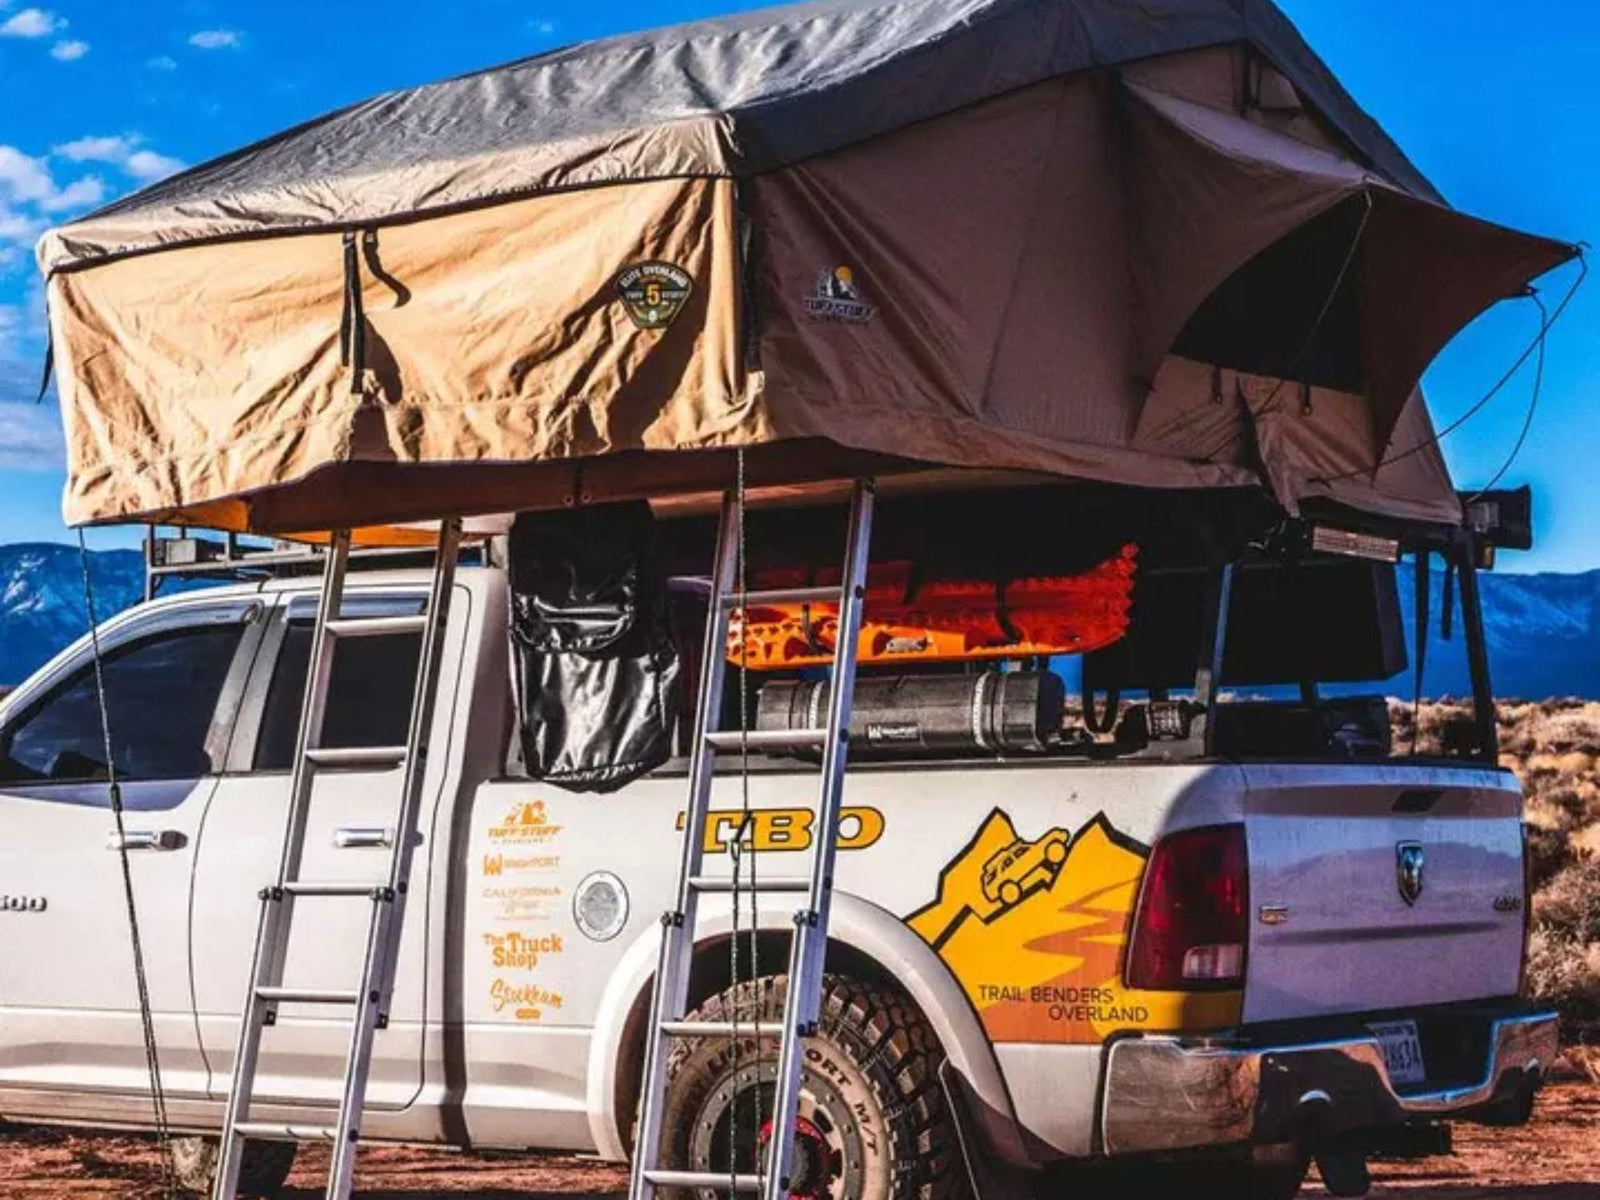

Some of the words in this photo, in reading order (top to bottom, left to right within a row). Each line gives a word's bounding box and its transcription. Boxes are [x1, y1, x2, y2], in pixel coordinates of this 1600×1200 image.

[646, 283, 661, 306] 5
[506, 931, 563, 953] Truck
[492, 946, 538, 970] Shop
[978, 985, 1027, 1001] TRAIL
[1030, 986, 1115, 1004] BENDERS
[1049, 1004, 1148, 1023] OVERLAND
